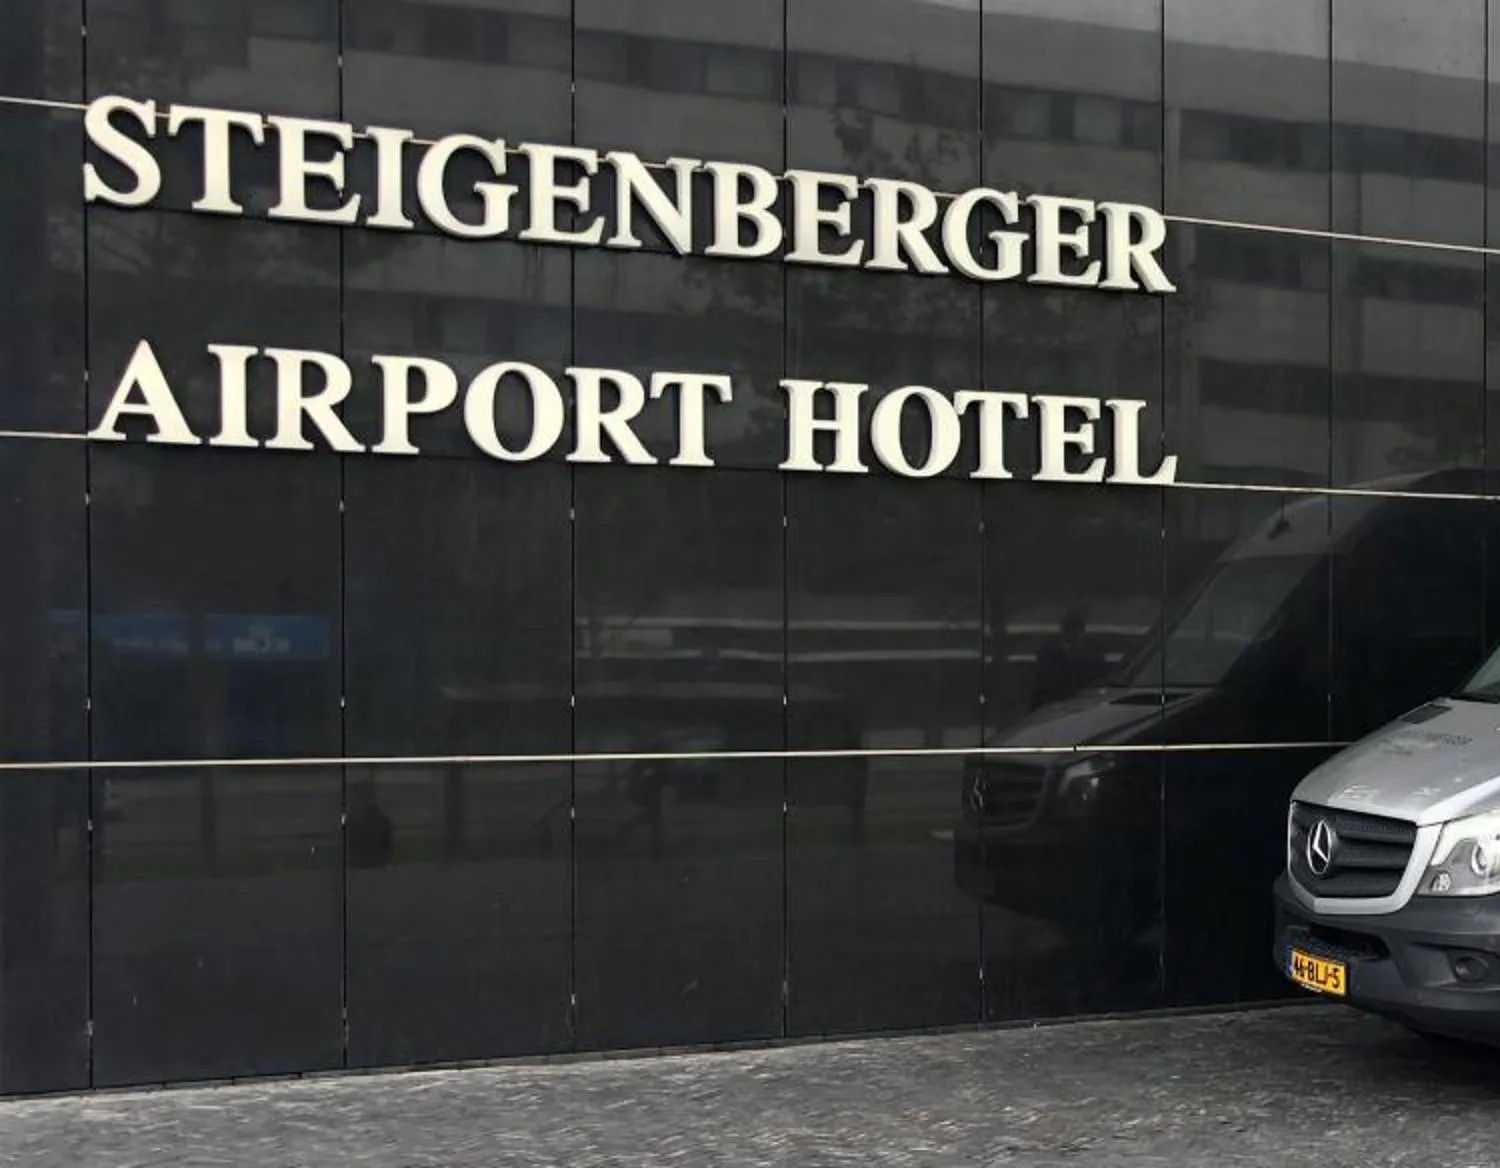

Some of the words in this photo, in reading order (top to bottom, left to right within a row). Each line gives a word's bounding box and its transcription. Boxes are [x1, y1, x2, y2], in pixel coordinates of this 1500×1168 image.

[83, 94, 1176, 293] STEIGENBERGER
[88, 338, 733, 468] AIRPORT
[778, 379, 1178, 486] HOTEL
